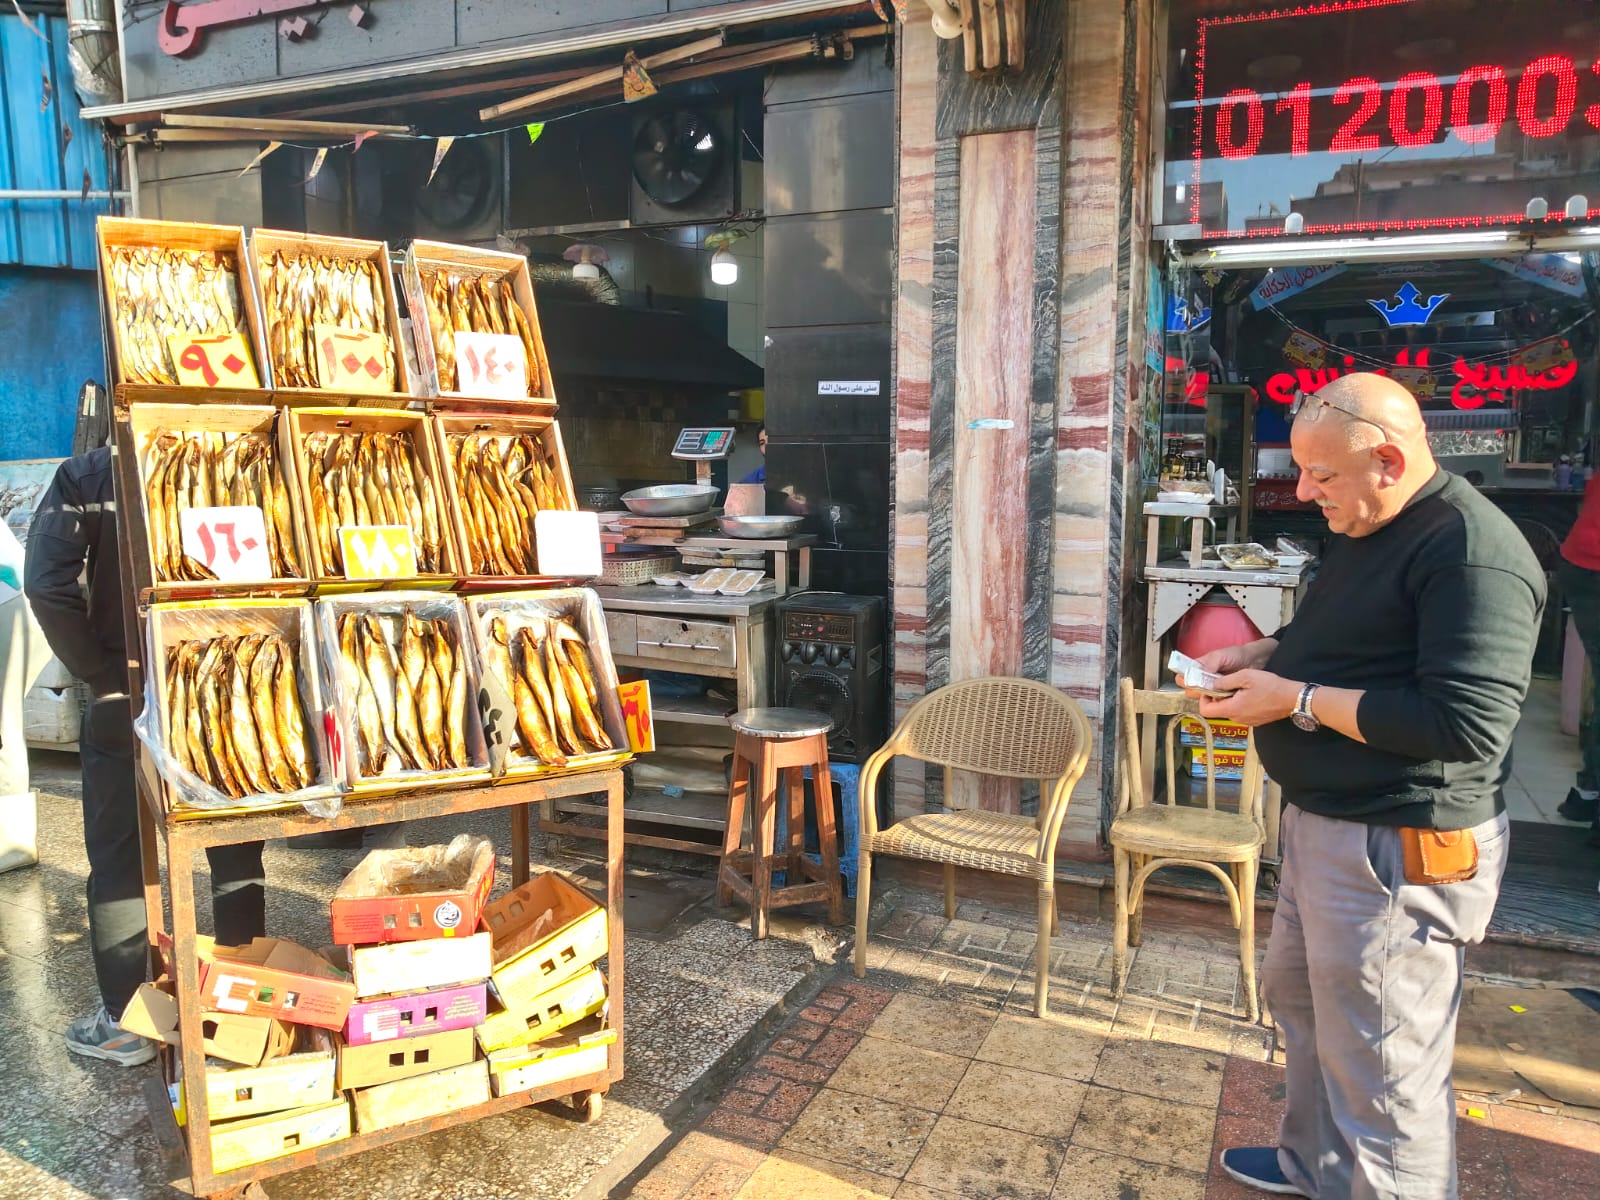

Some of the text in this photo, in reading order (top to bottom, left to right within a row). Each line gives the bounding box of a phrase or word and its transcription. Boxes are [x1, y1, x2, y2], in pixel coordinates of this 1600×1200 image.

[180, 344, 246, 387] ٩٠
[321, 337, 384, 384] ١٠٠
[464, 344, 517, 384] ١٤٠
[821, 383, 833, 391] الله
[197, 521, 259, 569] ١٦٠
[350, 528, 409, 577] ١٨٠
[1220, 727, 1248, 737] مارينا
